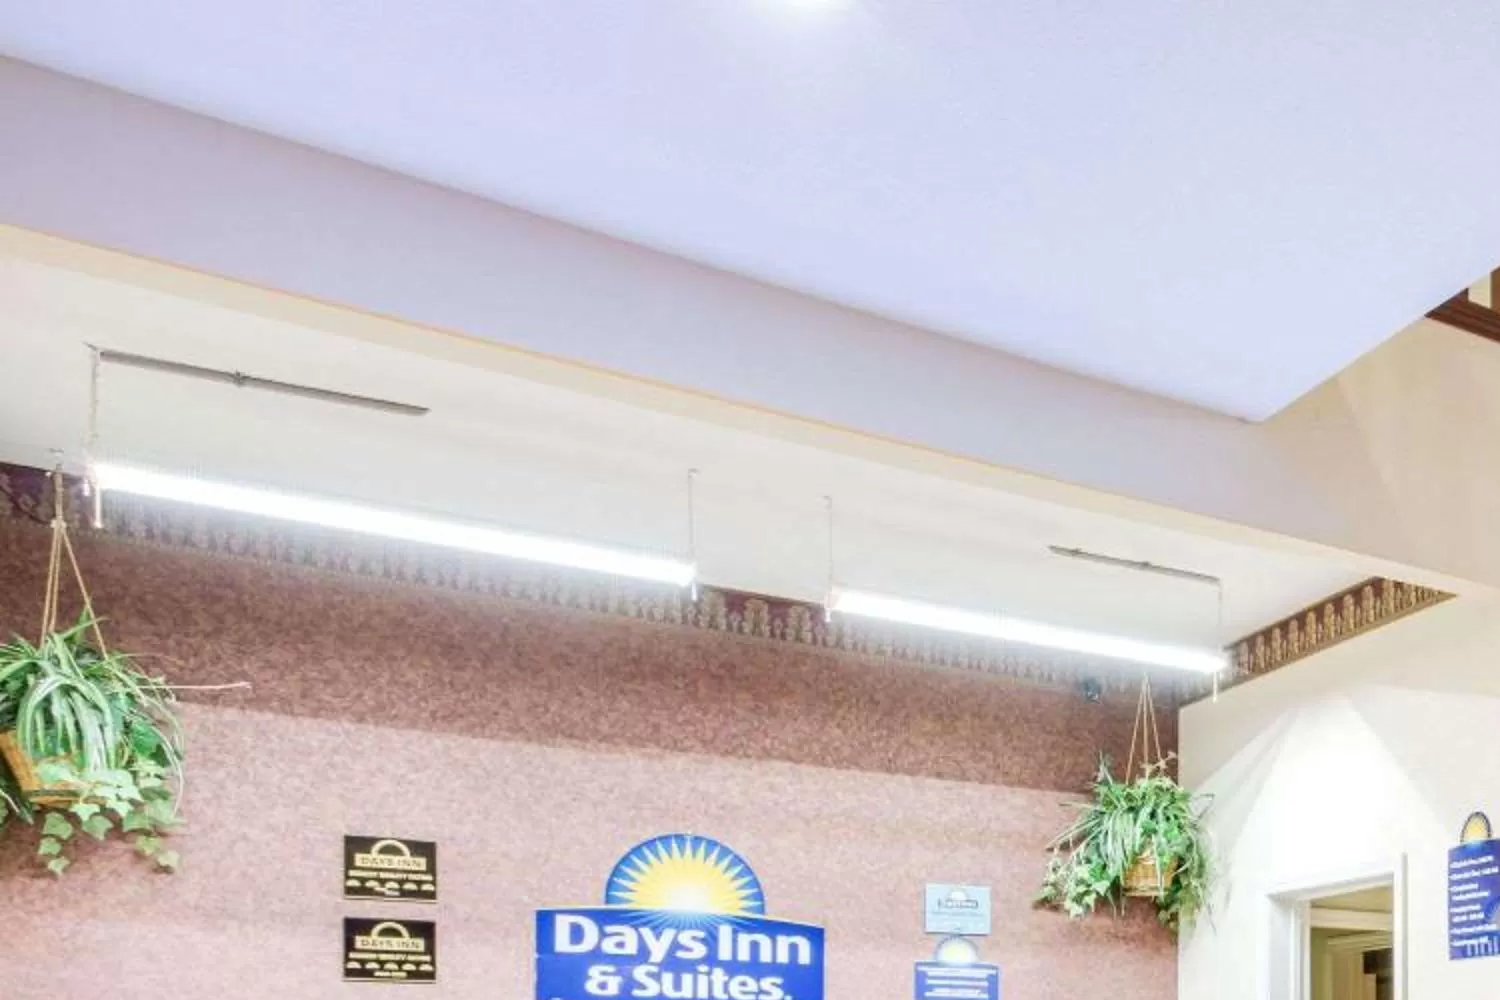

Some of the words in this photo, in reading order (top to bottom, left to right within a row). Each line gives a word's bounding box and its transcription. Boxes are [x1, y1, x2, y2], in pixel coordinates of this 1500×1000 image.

[554, 913, 707, 963] Days
[717, 925, 811, 965] Inn
[584, 964, 622, 996] &
